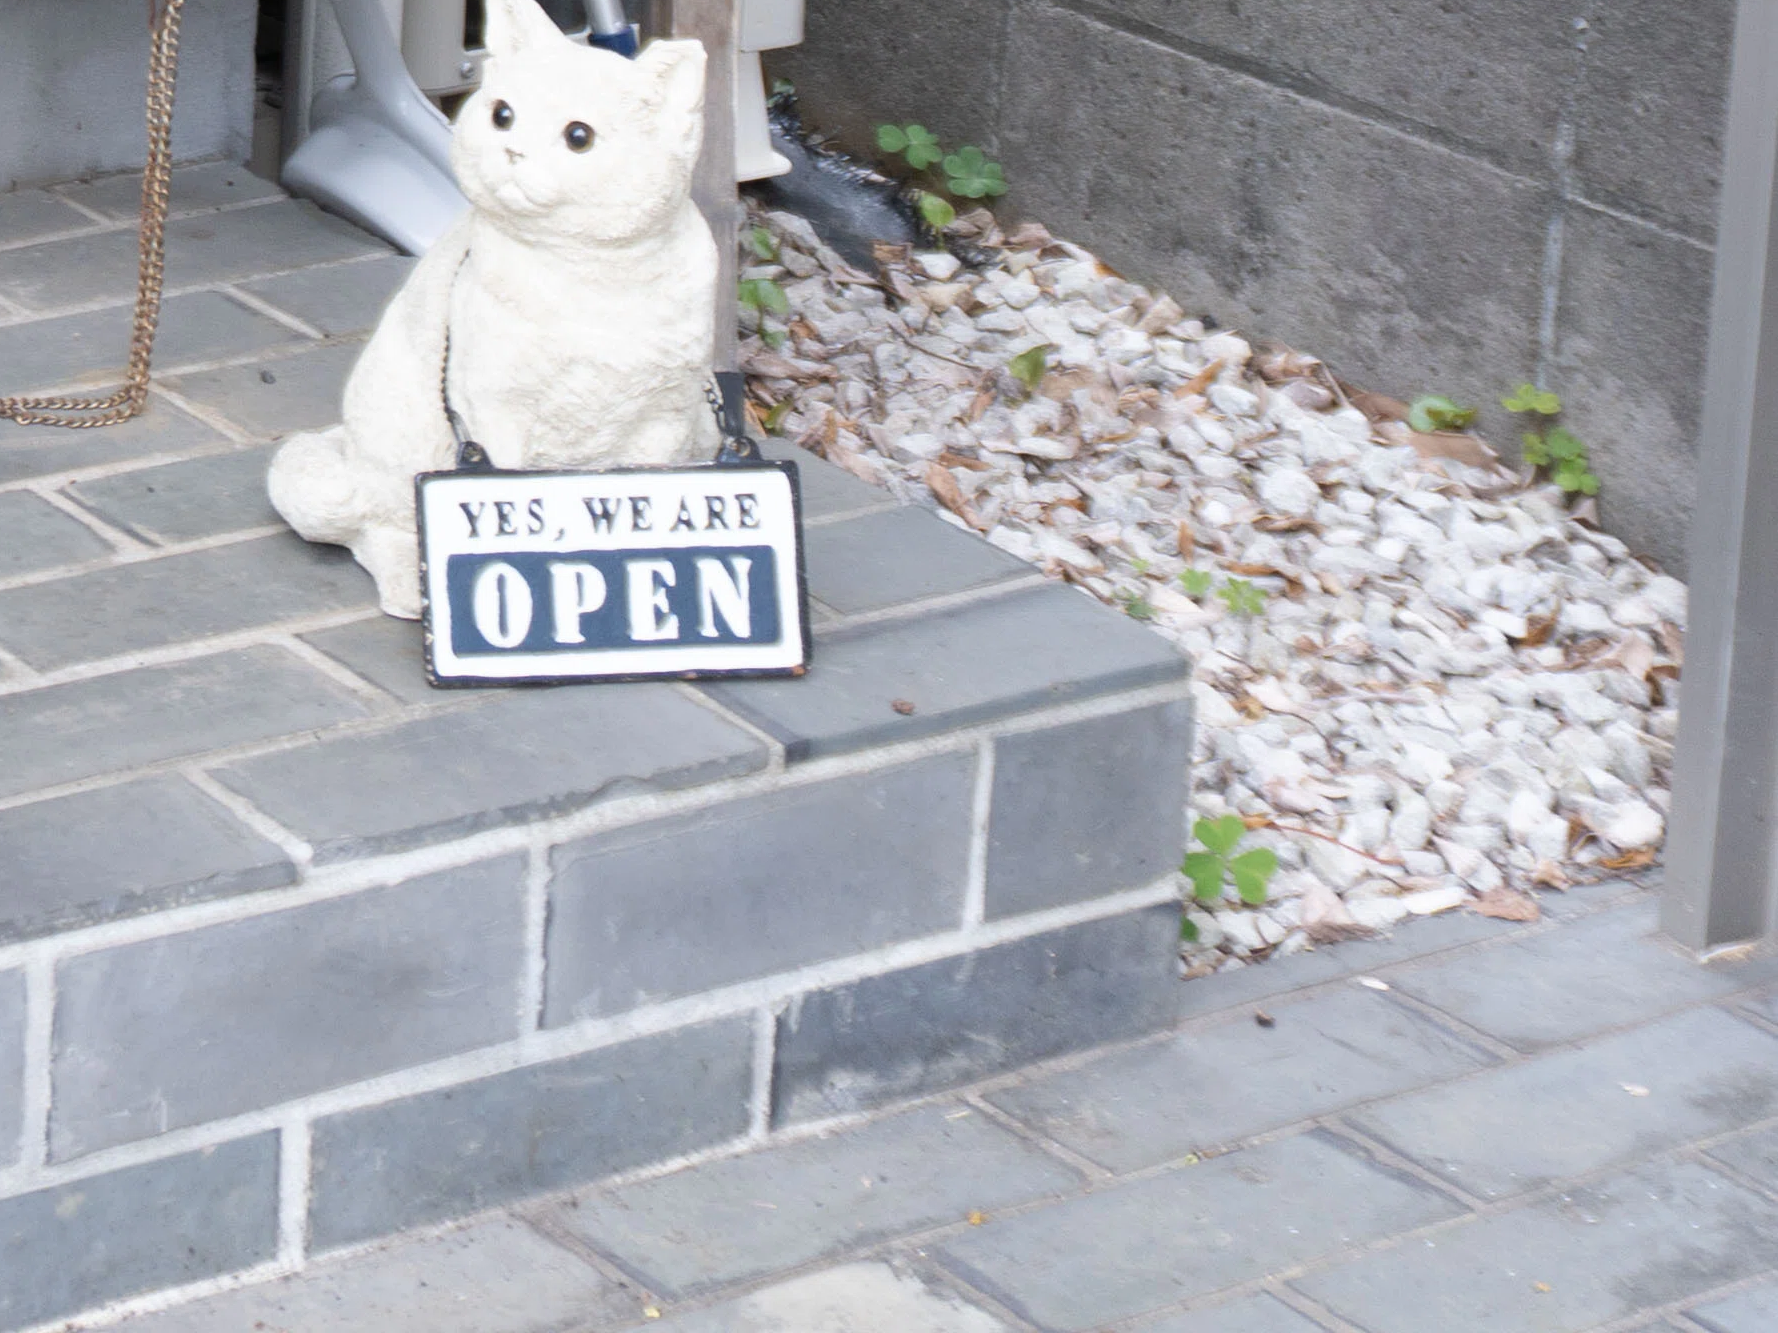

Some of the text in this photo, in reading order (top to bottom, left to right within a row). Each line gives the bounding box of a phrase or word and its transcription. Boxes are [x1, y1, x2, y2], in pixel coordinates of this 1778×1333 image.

[459, 492, 762, 542] YES, WE ARE
[473, 556, 754, 650] OPEN
